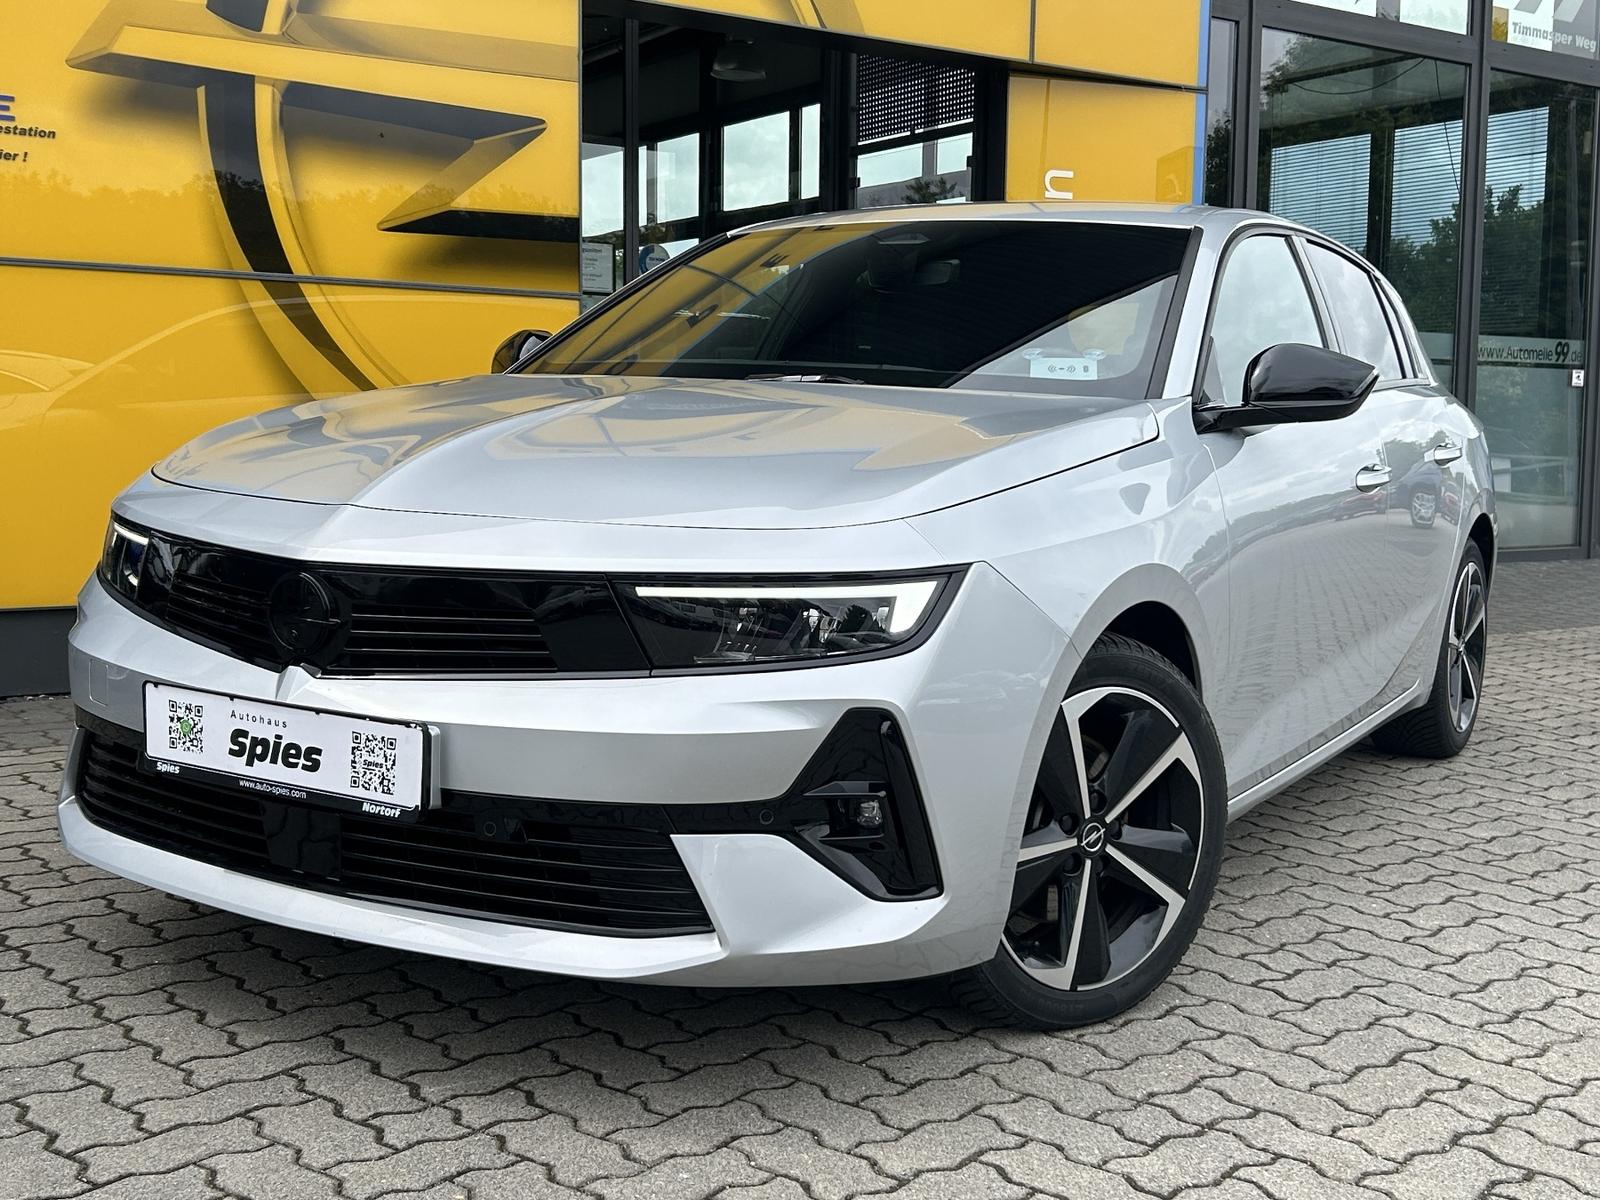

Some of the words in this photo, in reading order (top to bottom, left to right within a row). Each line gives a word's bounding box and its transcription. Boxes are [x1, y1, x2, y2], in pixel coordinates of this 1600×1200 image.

[1512, 22, 1573, 46] Timmasper
[1575, 35, 1597, 53] Weg
[230, 709, 288, 728] Autohaus
[228, 728, 323, 773] Spies
[156, 761, 180, 774] Spies
[362, 759, 384, 769] Spies
[238, 778, 307, 799] www.auto-spies.com
[362, 802, 401, 818] Nortorf
